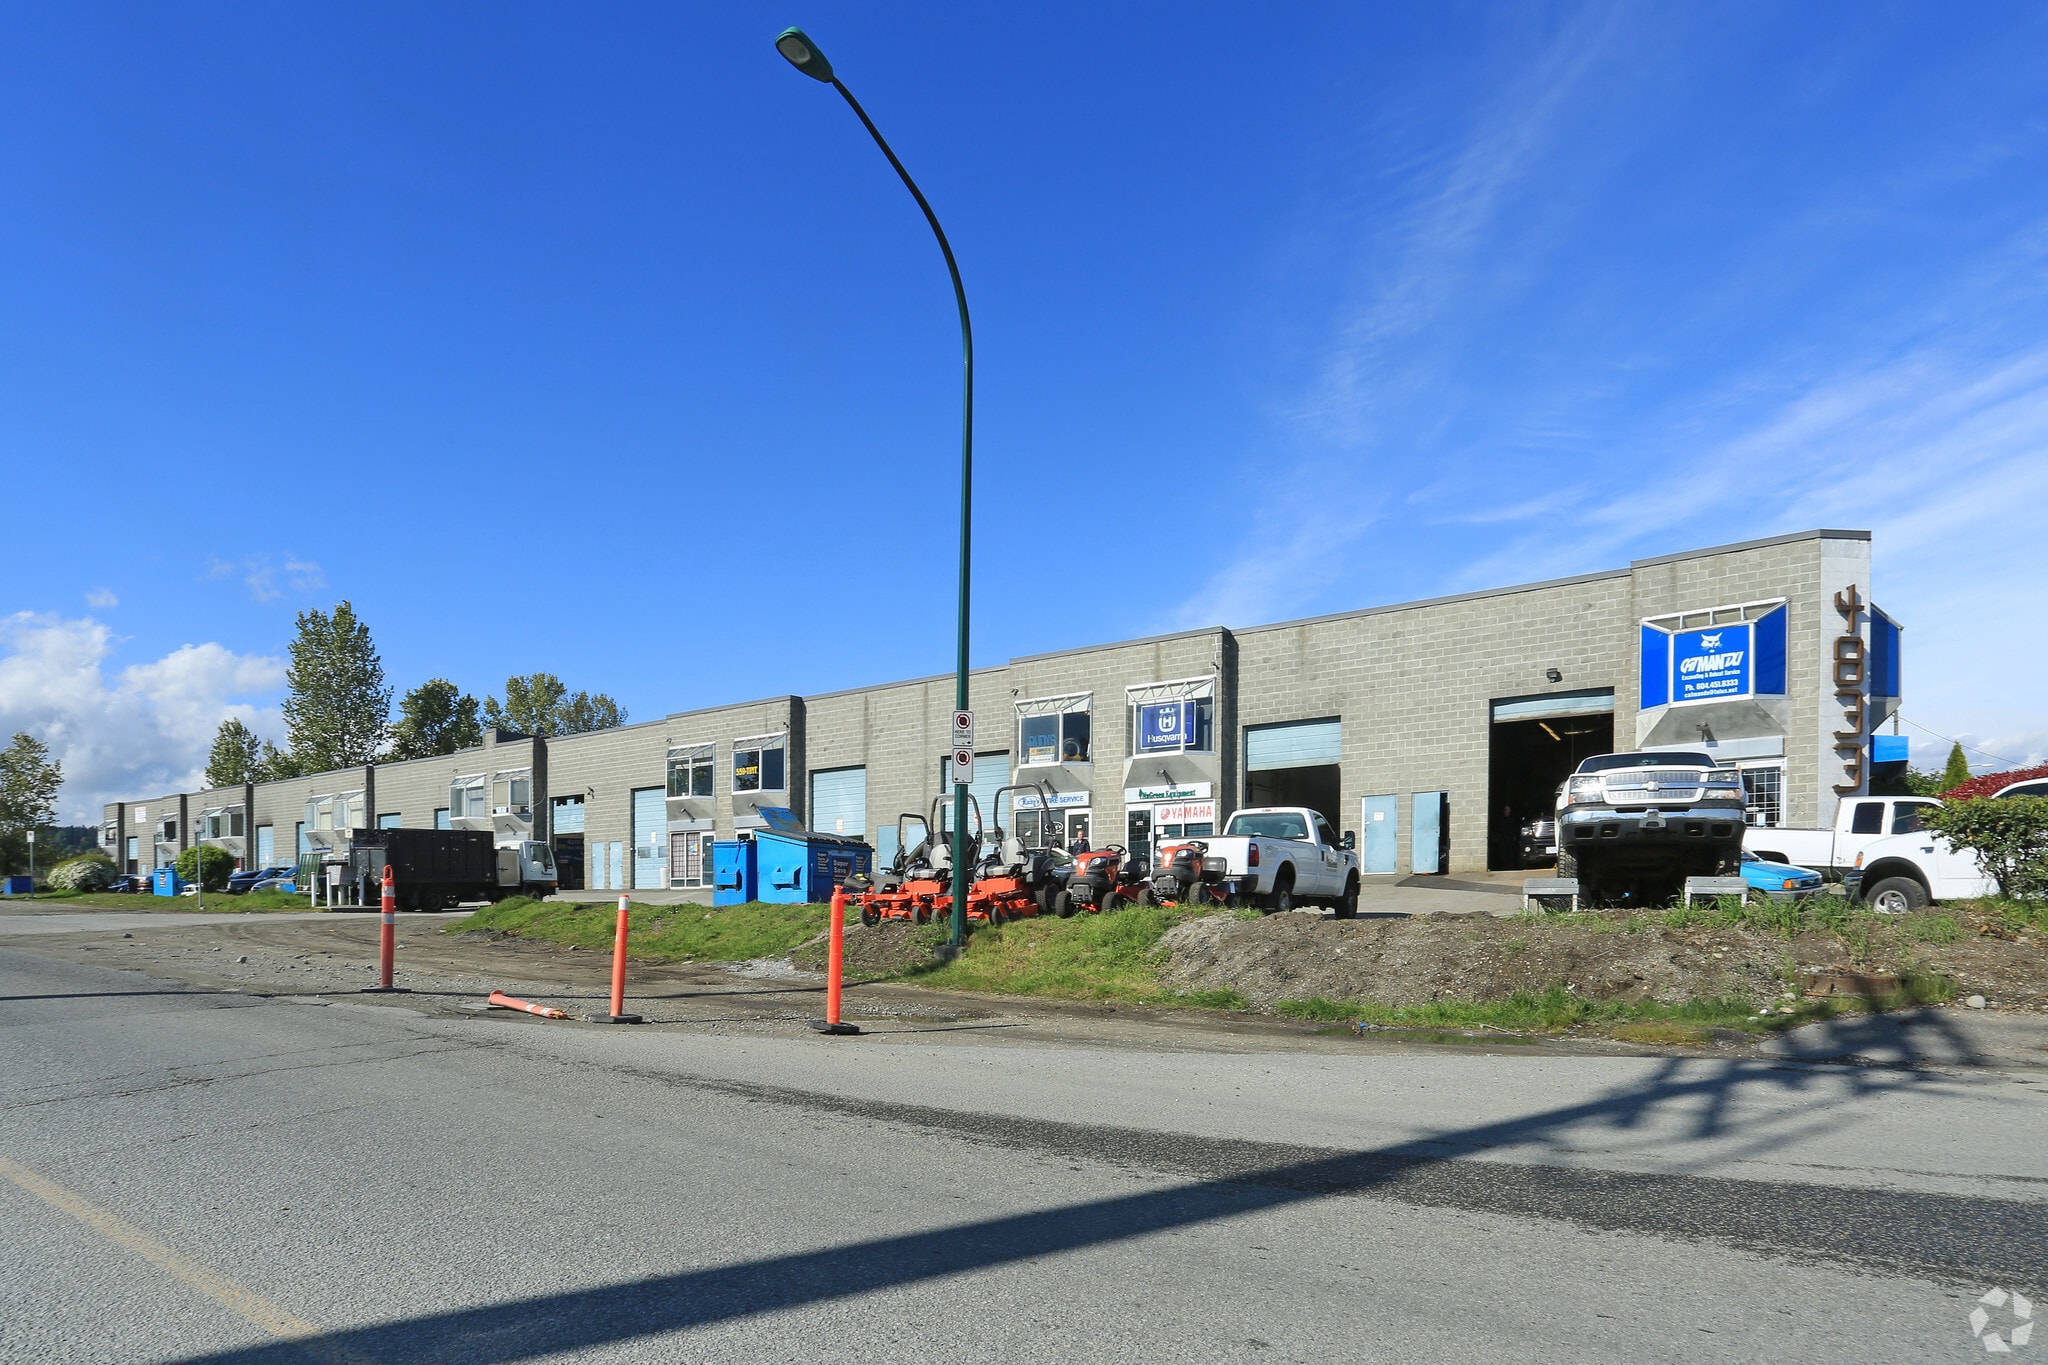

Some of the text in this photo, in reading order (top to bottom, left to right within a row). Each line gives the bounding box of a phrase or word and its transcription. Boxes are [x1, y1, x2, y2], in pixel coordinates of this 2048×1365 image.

[1832, 583, 1865, 792] 4833
[1060, 795, 1084, 803] SERVICE
[1171, 805, 1212, 819] YAMAHA
